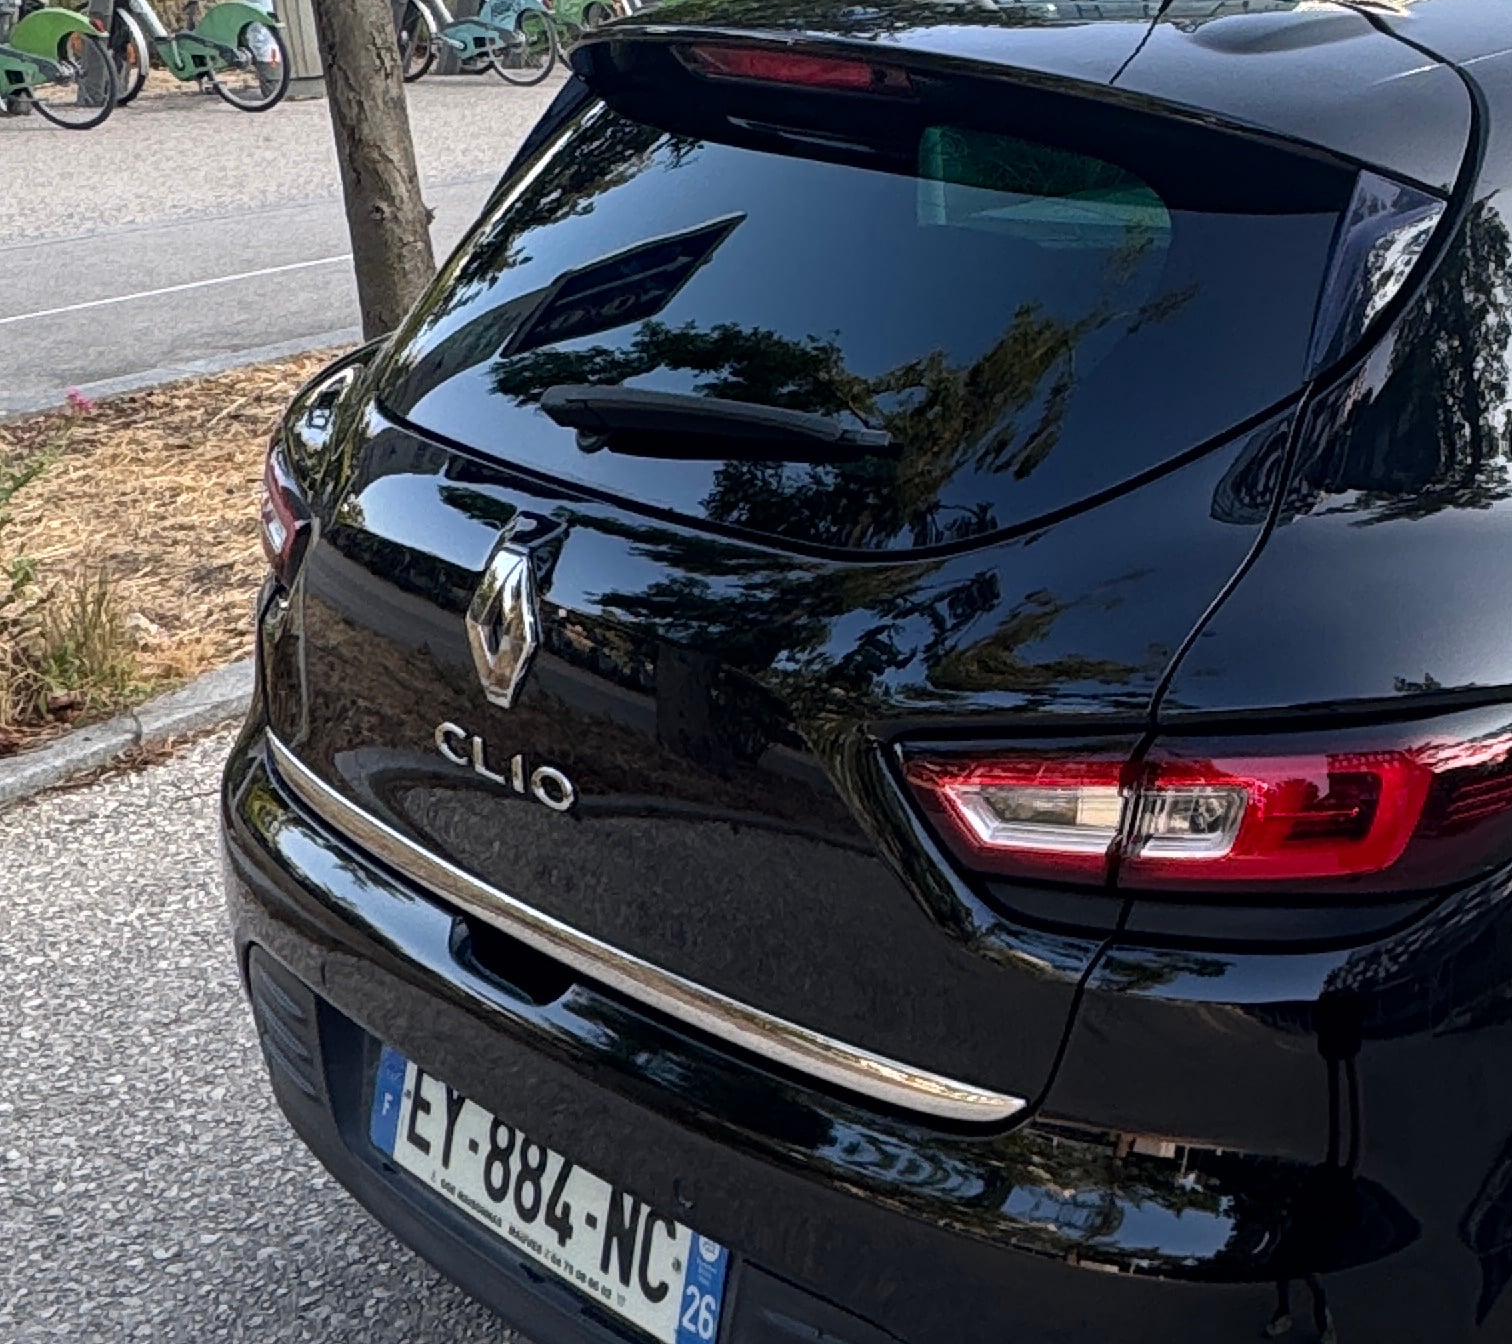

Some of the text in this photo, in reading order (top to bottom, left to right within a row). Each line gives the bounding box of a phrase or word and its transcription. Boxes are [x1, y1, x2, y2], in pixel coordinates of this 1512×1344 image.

[433, 721, 575, 811] CLIO
[406, 1067, 677, 1304] EY-884-NC
[681, 1283, 716, 1341] 26
